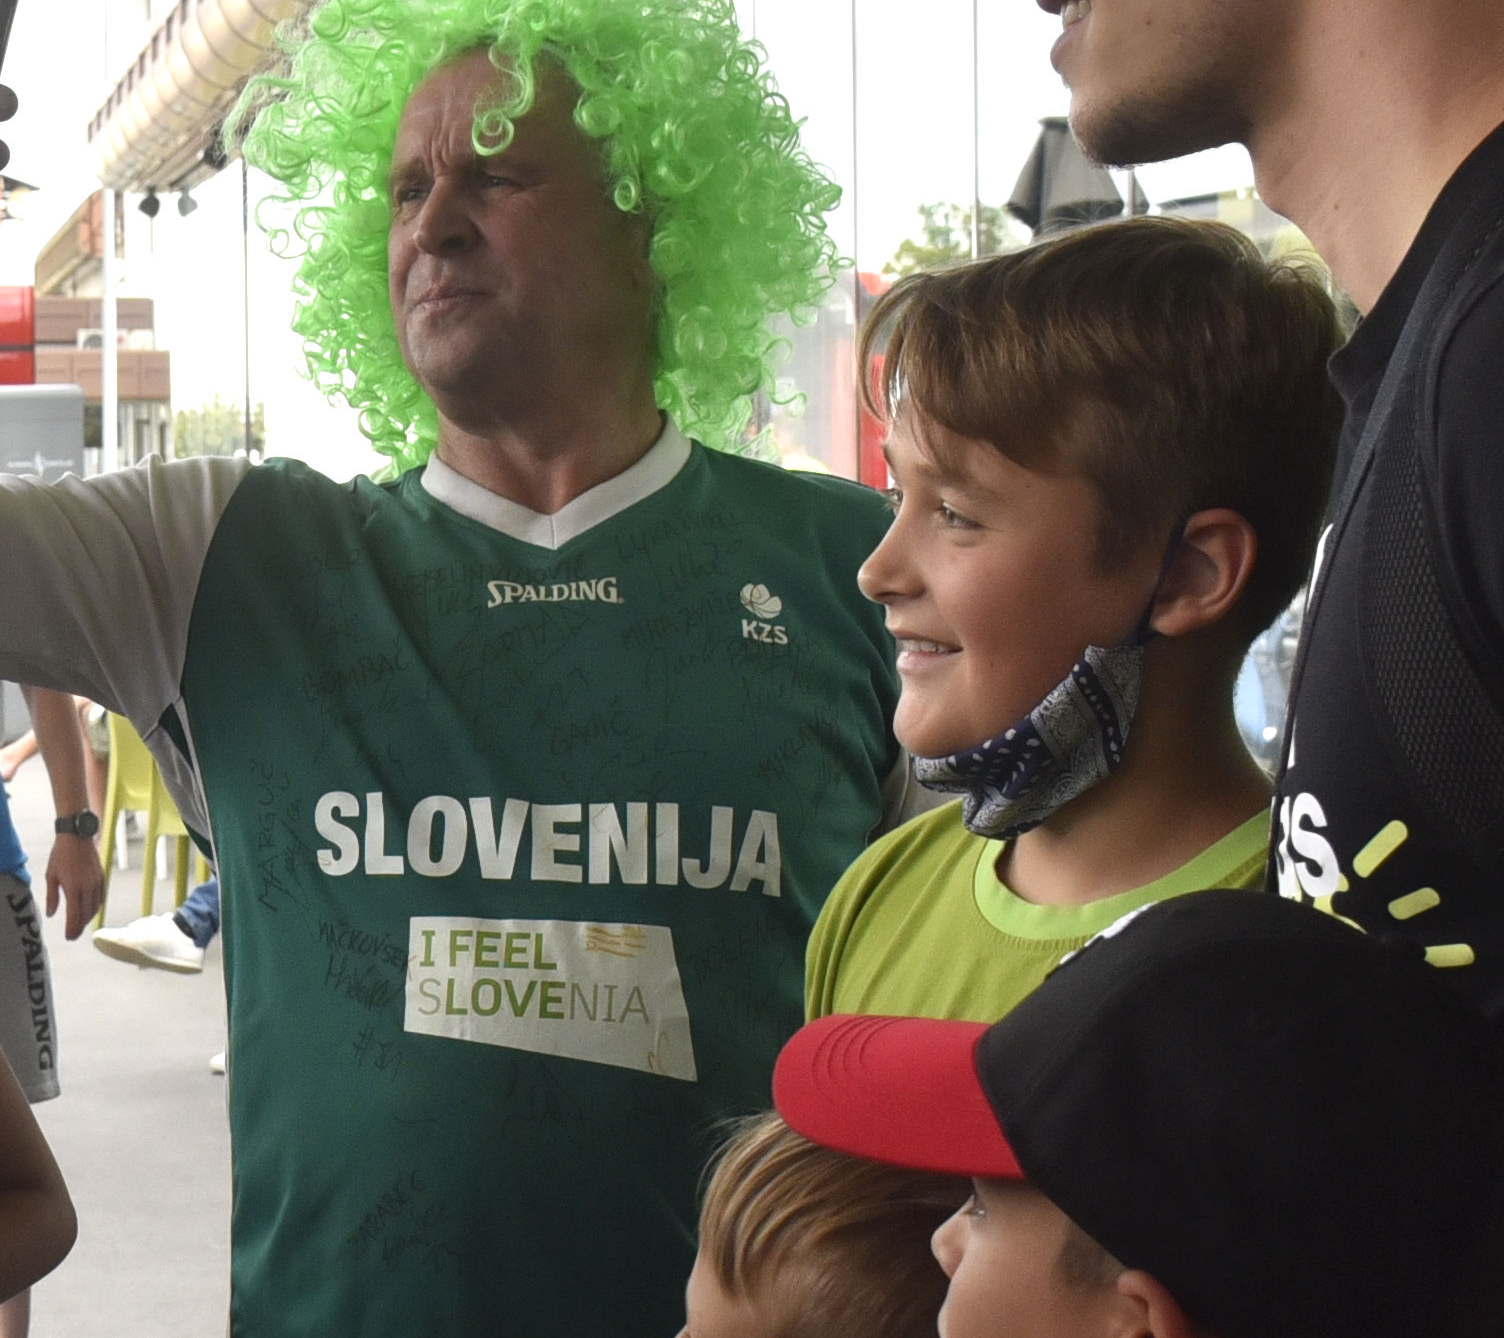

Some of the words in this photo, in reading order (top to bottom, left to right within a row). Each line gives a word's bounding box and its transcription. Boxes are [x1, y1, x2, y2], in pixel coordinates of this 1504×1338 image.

[487, 577, 618, 609] SPALDING
[741, 618, 789, 645] KZS
[313, 789, 782, 898] SLOVENIJA
[418, 929, 437, 968] I
[448, 929, 558, 971] FEEL
[417, 976, 650, 1025] SLOVENIA
